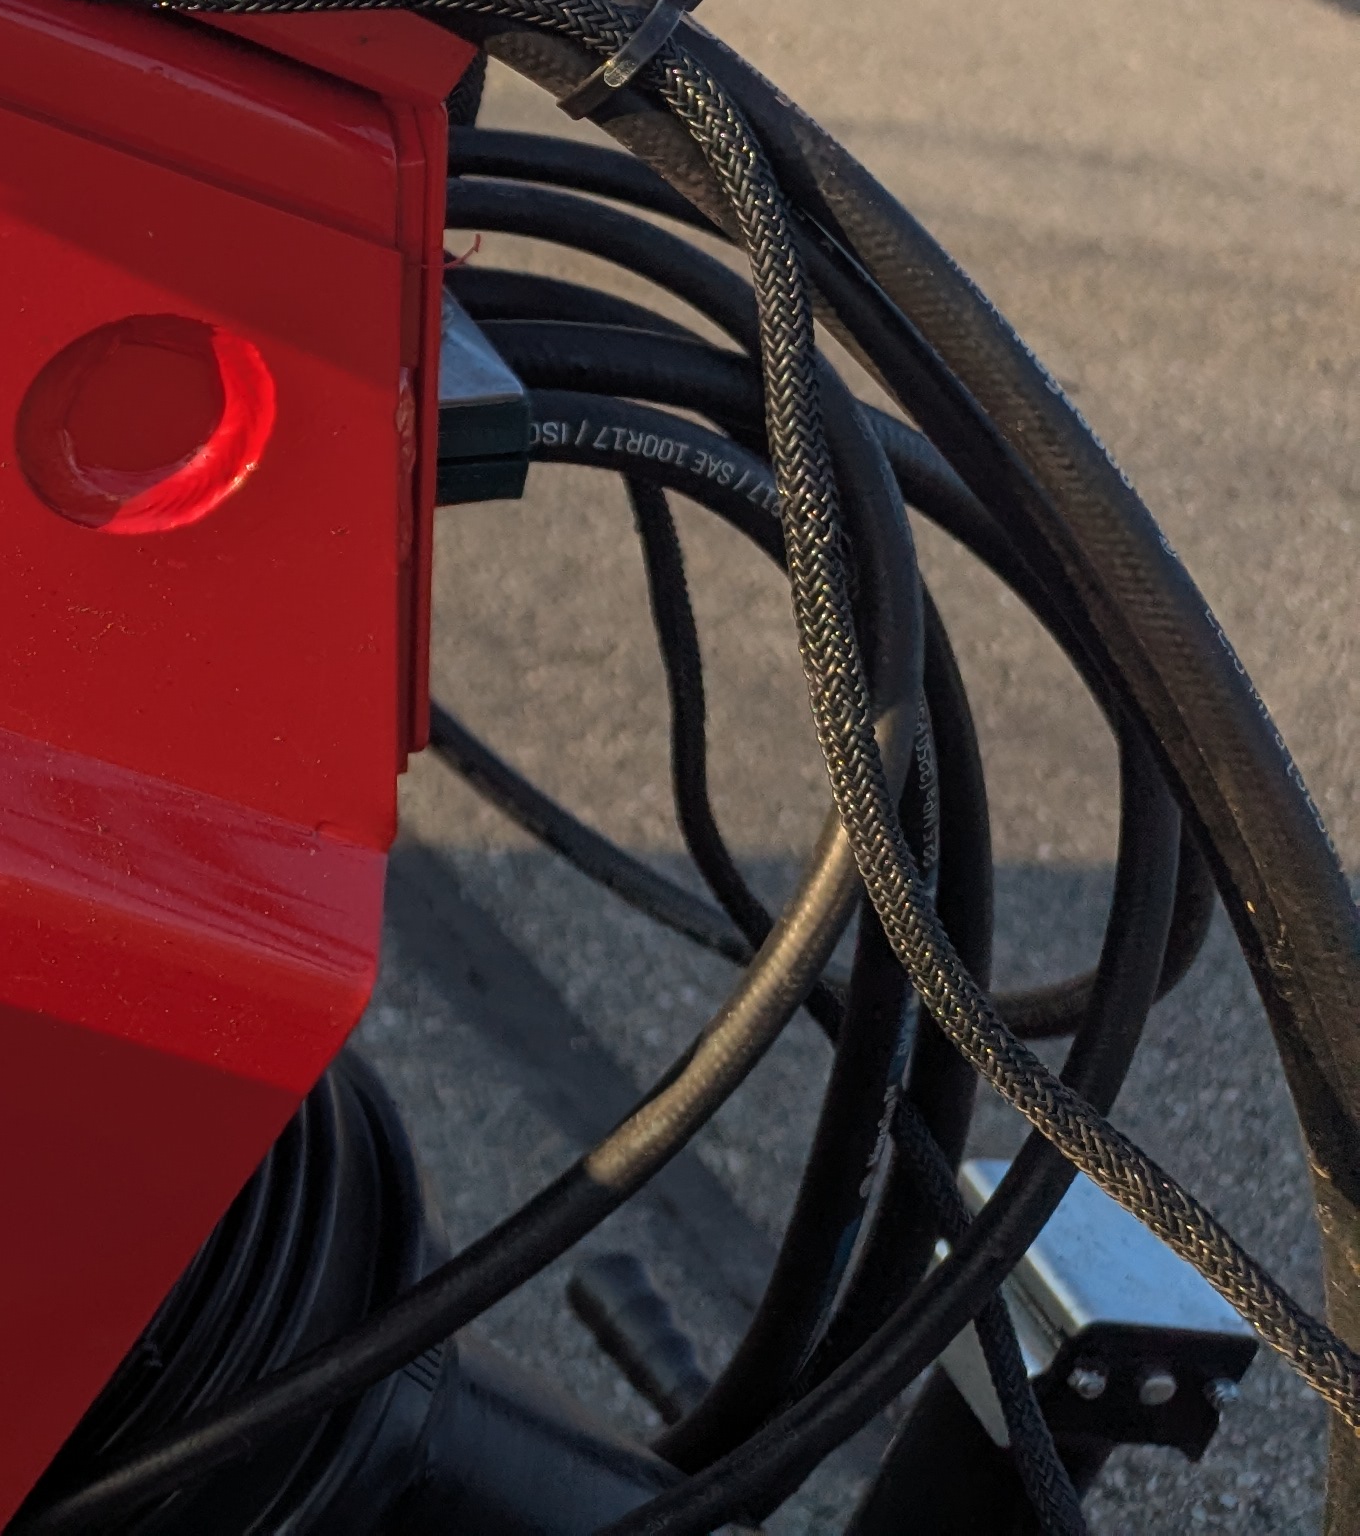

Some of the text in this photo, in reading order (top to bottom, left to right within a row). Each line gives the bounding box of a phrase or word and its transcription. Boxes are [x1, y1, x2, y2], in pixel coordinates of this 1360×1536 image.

[575, 419, 589, 446] /
[593, 426, 689, 465] 100R17
[691, 450, 735, 485] SAE
[733, 470, 750, 490] /
